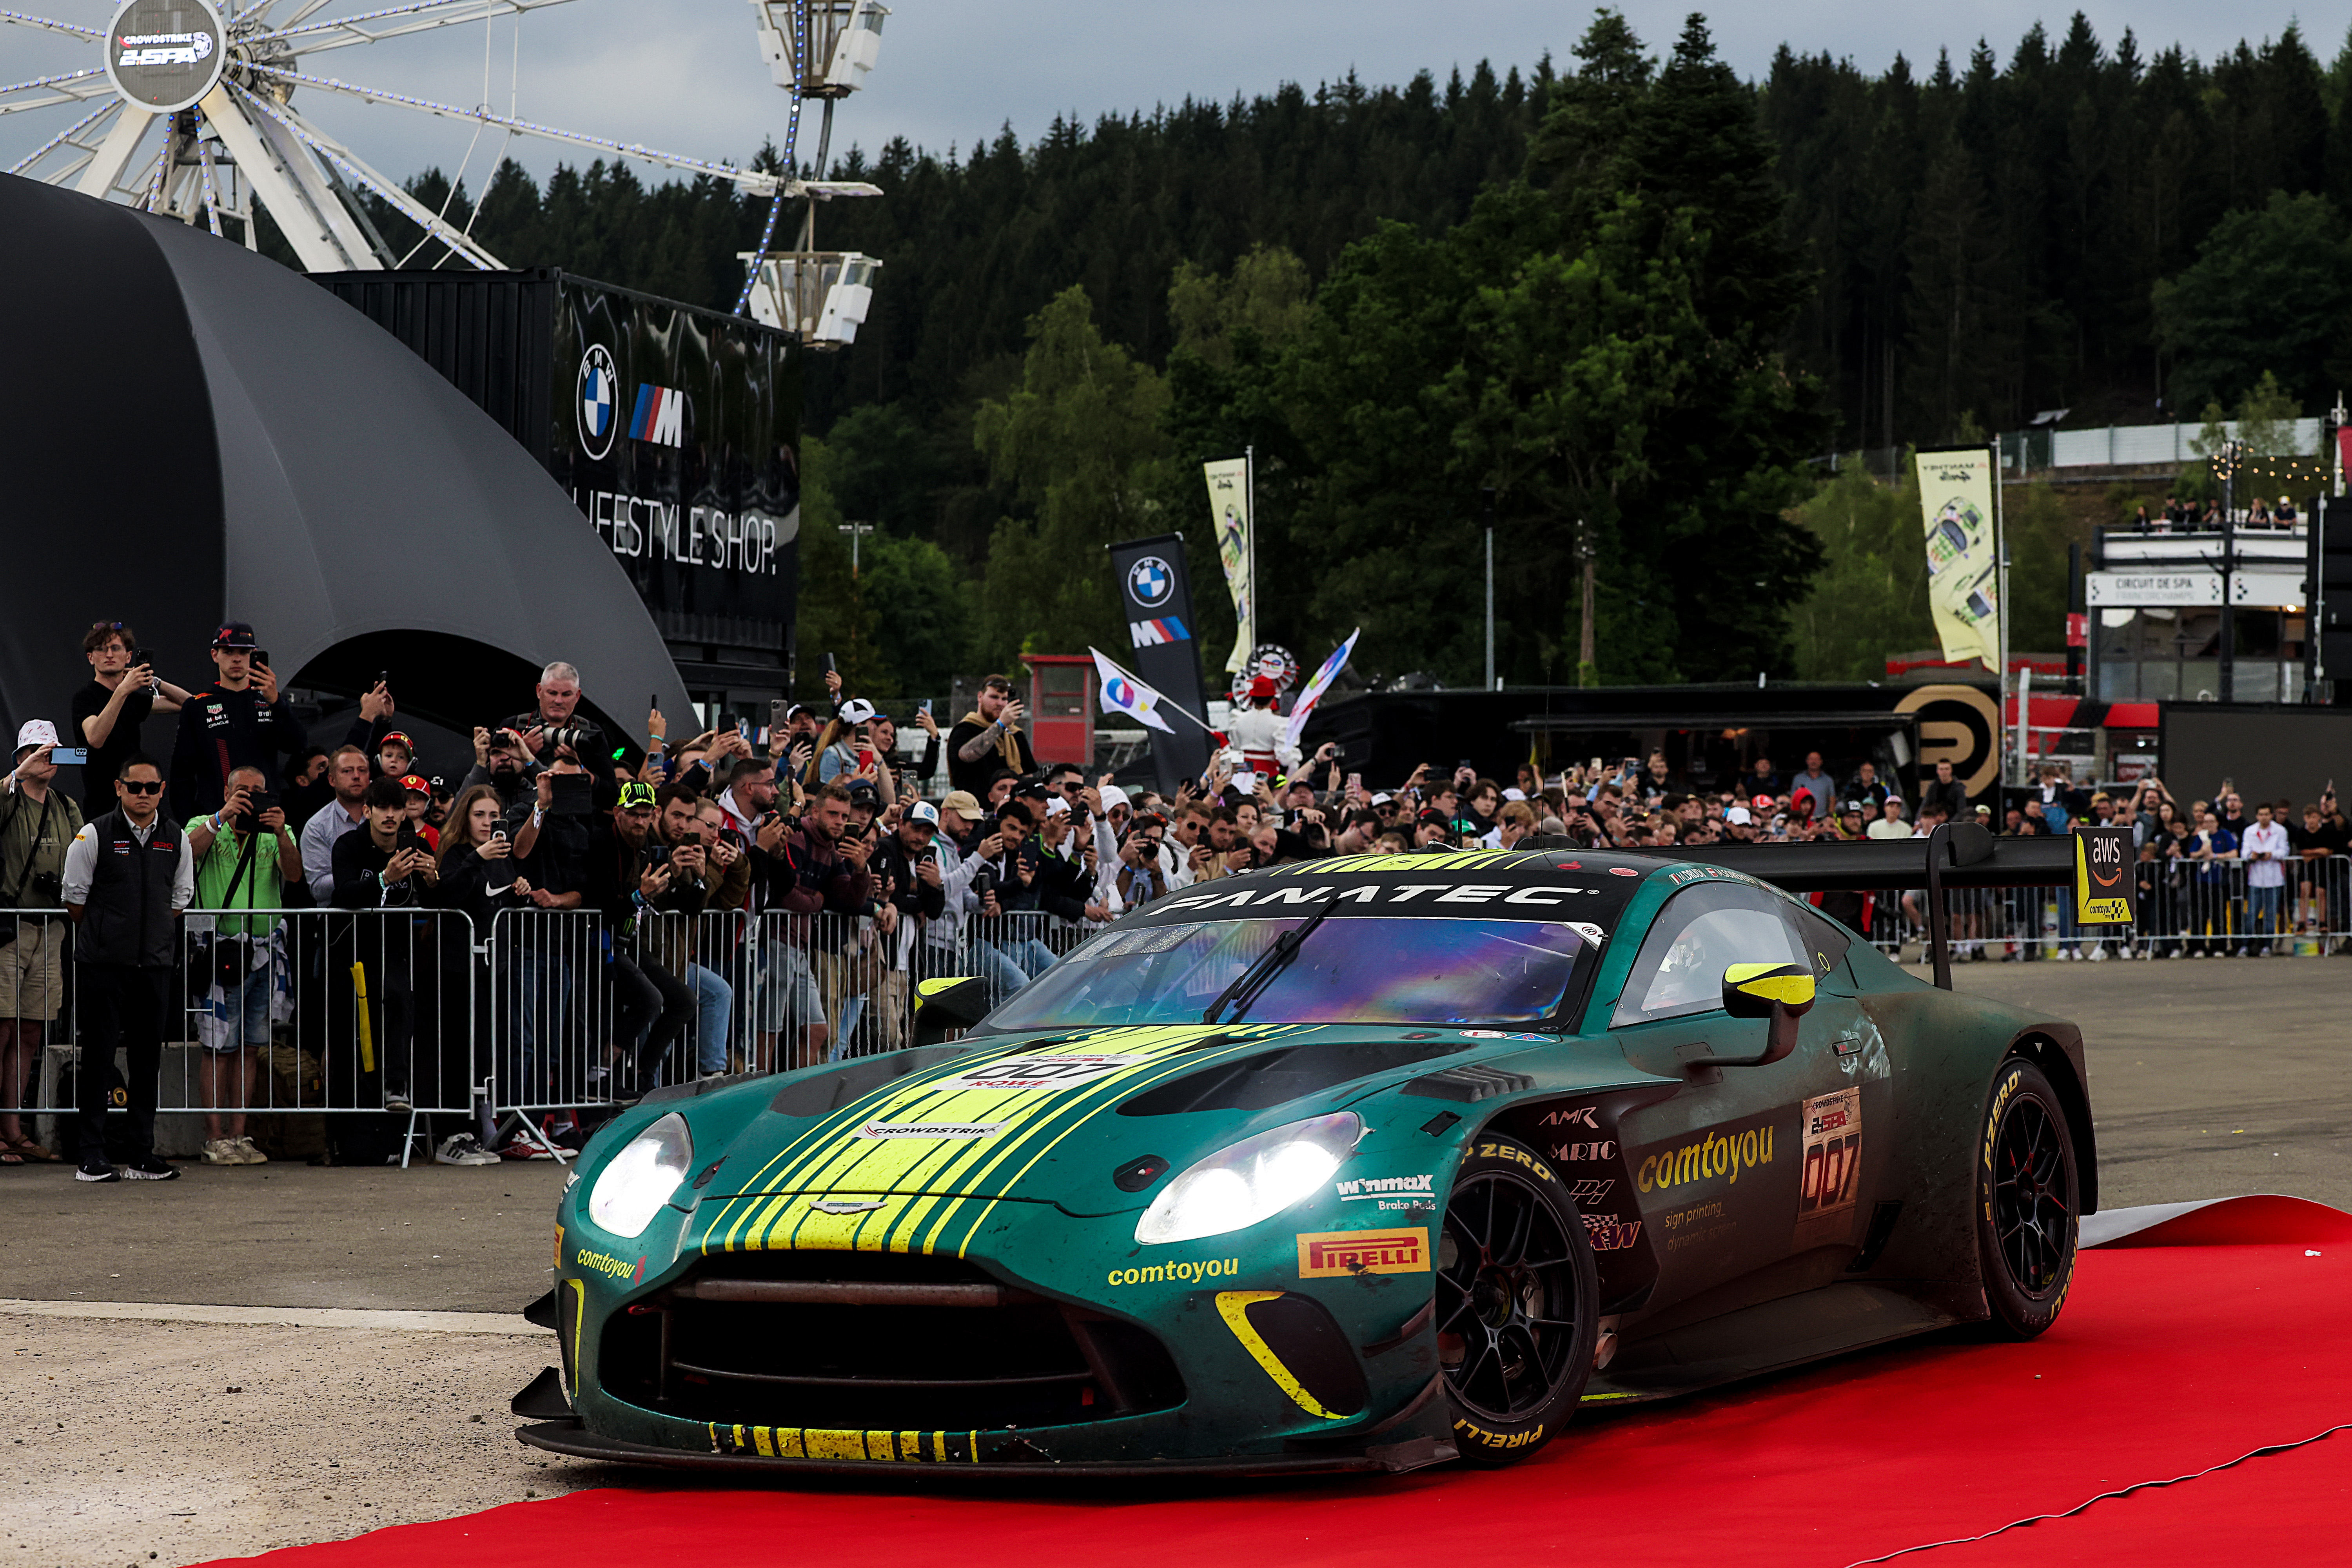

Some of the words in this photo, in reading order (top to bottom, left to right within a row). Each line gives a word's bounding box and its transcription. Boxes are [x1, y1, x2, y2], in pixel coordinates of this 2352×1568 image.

[123, 33, 192, 45] CROWDSTRIKE
[583, 351, 613, 383] BMW
[711, 510, 776, 575] SHOP.
[2173, 577, 2192, 588] SPA
[2093, 837, 2121, 863] aws
[1145, 885, 1584, 916] FANATEC
[2090, 904, 2111, 916] comtoyou
[961, 1063, 1126, 1080] 007
[1813, 1094, 1844, 1110] CROWDSTRIKE
[1637, 1125, 1773, 1193] comtoyou
[1800, 1132, 1860, 1212] 007
[1378, 1200, 1410, 1210] Brake
[1665, 1210, 1684, 1230] sign
[1309, 1236, 1419, 1269] PIRELLI
[1668, 1227, 1706, 1253] dynamic
[577, 1249, 636, 1279] comtoyou
[1108, 1258, 1238, 1286] comtoyou
[1453, 1418, 1544, 1448] PIRELLI
